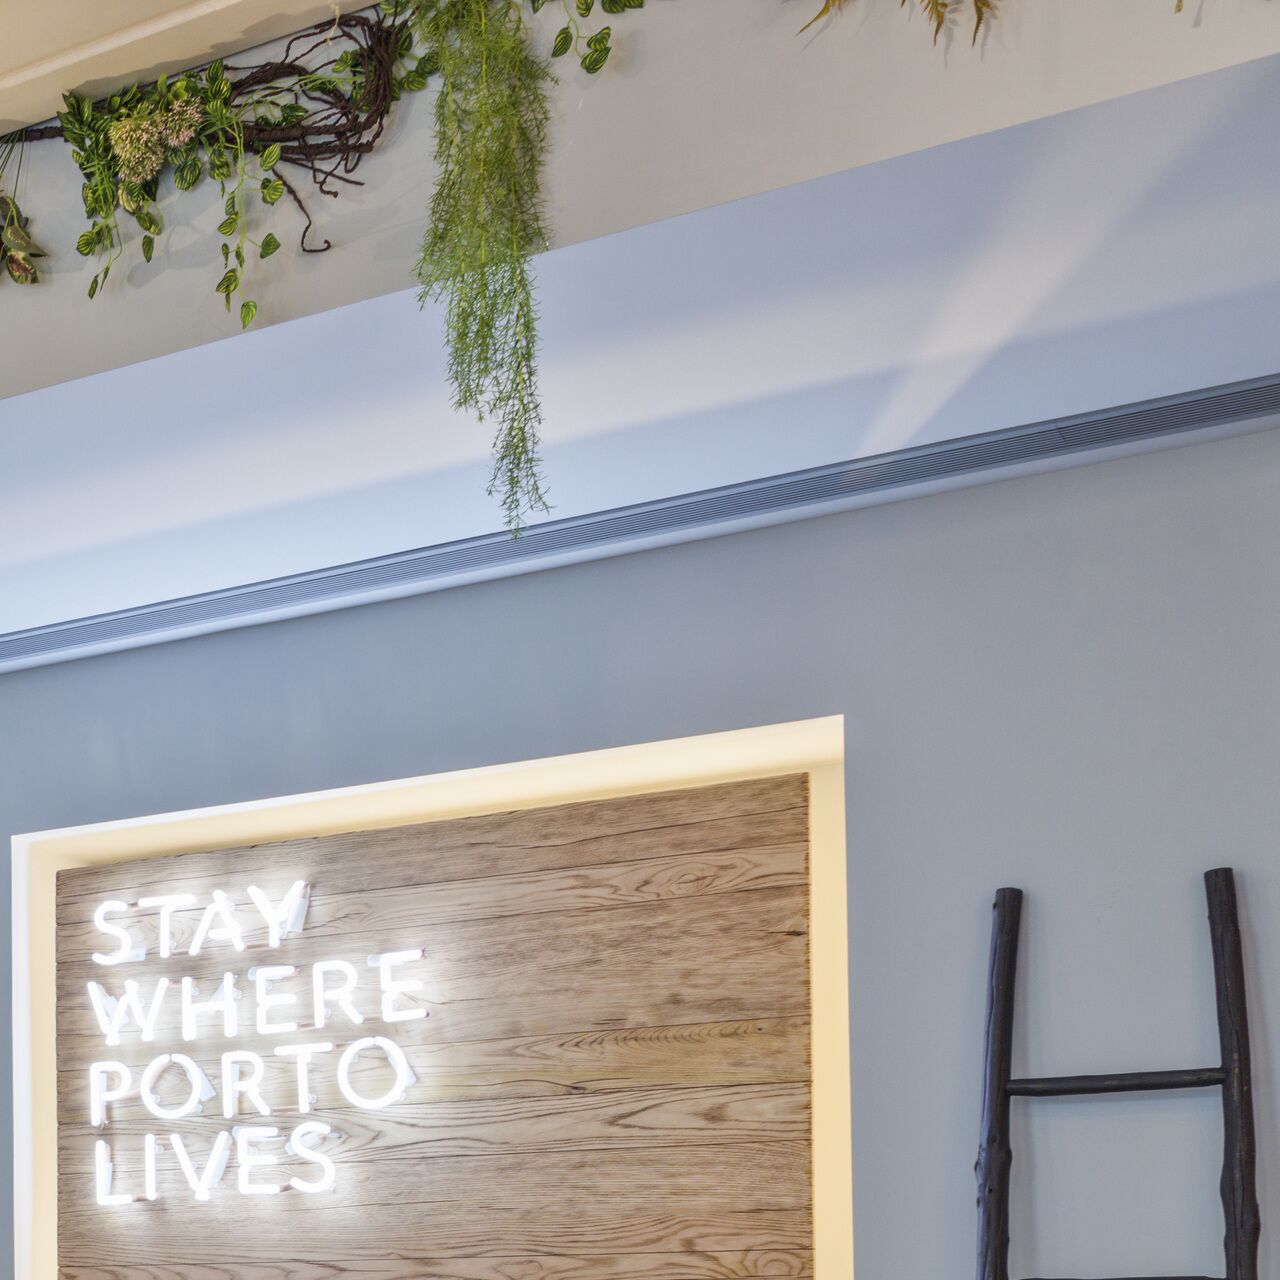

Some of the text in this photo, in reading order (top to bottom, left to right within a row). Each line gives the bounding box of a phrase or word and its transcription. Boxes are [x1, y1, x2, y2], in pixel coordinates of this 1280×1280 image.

[91, 880, 308, 965] STAY
[87, 949, 430, 1045] WHERE
[90, 1037, 408, 1126] PORTO
[95, 1122, 336, 1205] LIVES
